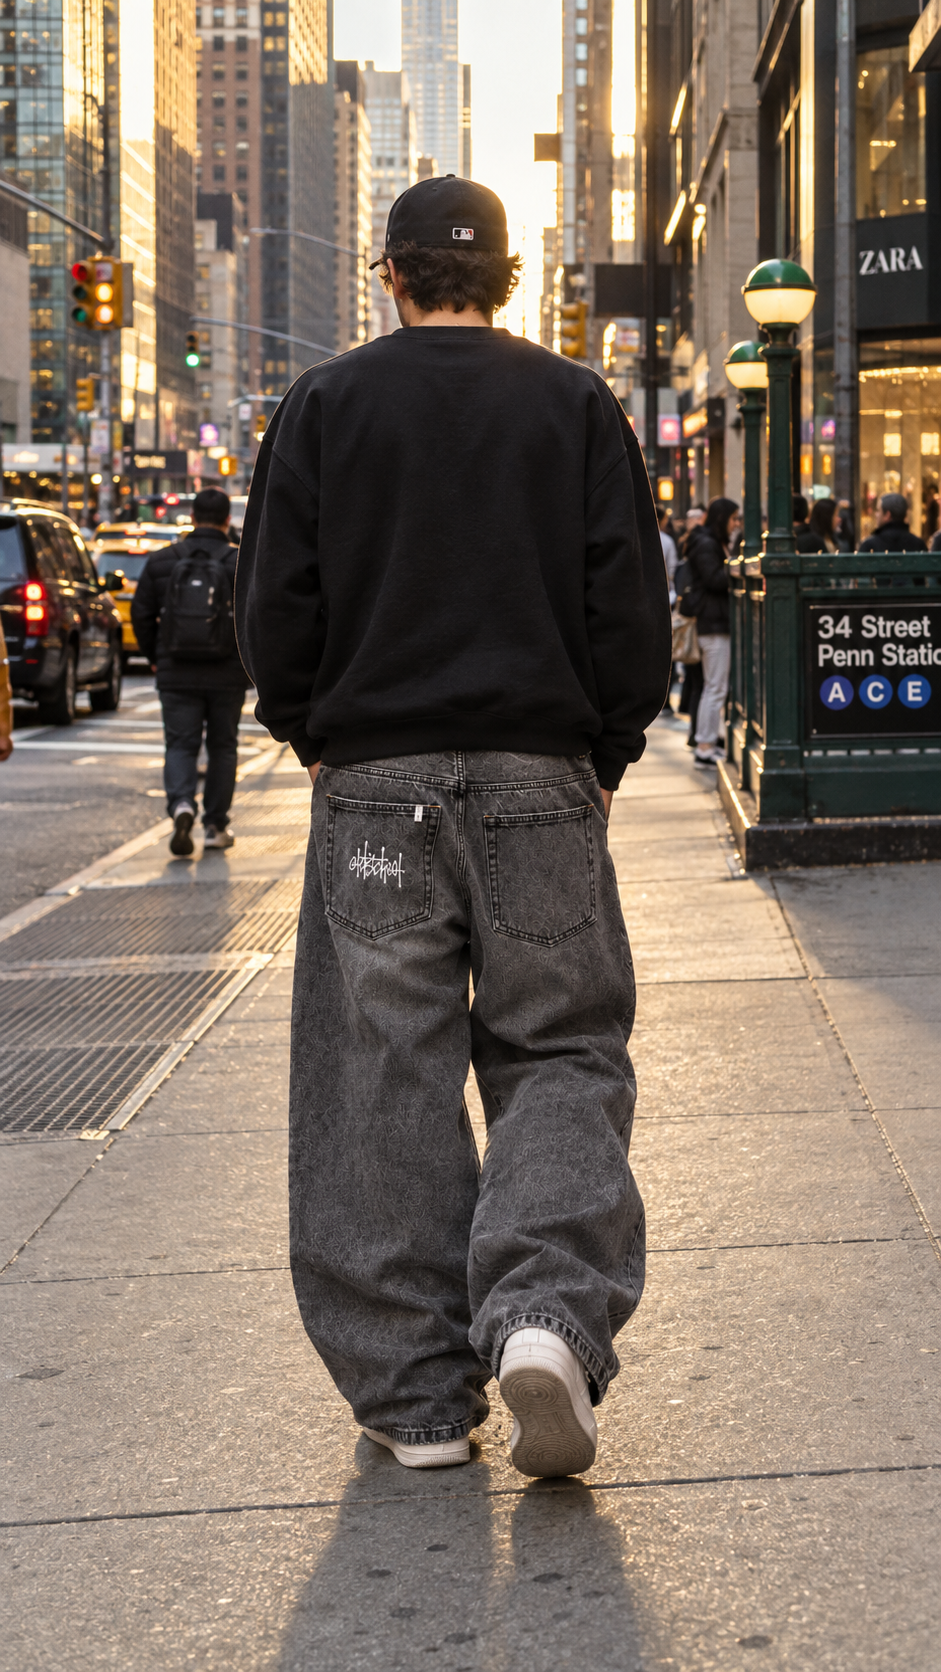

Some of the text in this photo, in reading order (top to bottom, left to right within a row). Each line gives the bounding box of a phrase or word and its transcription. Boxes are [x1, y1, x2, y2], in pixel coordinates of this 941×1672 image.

[858, 245, 924, 276] ZARA
[818, 614, 931, 639] 34 Street
[818, 643, 875, 667] Penn
[827, 680, 923, 703] A C E
